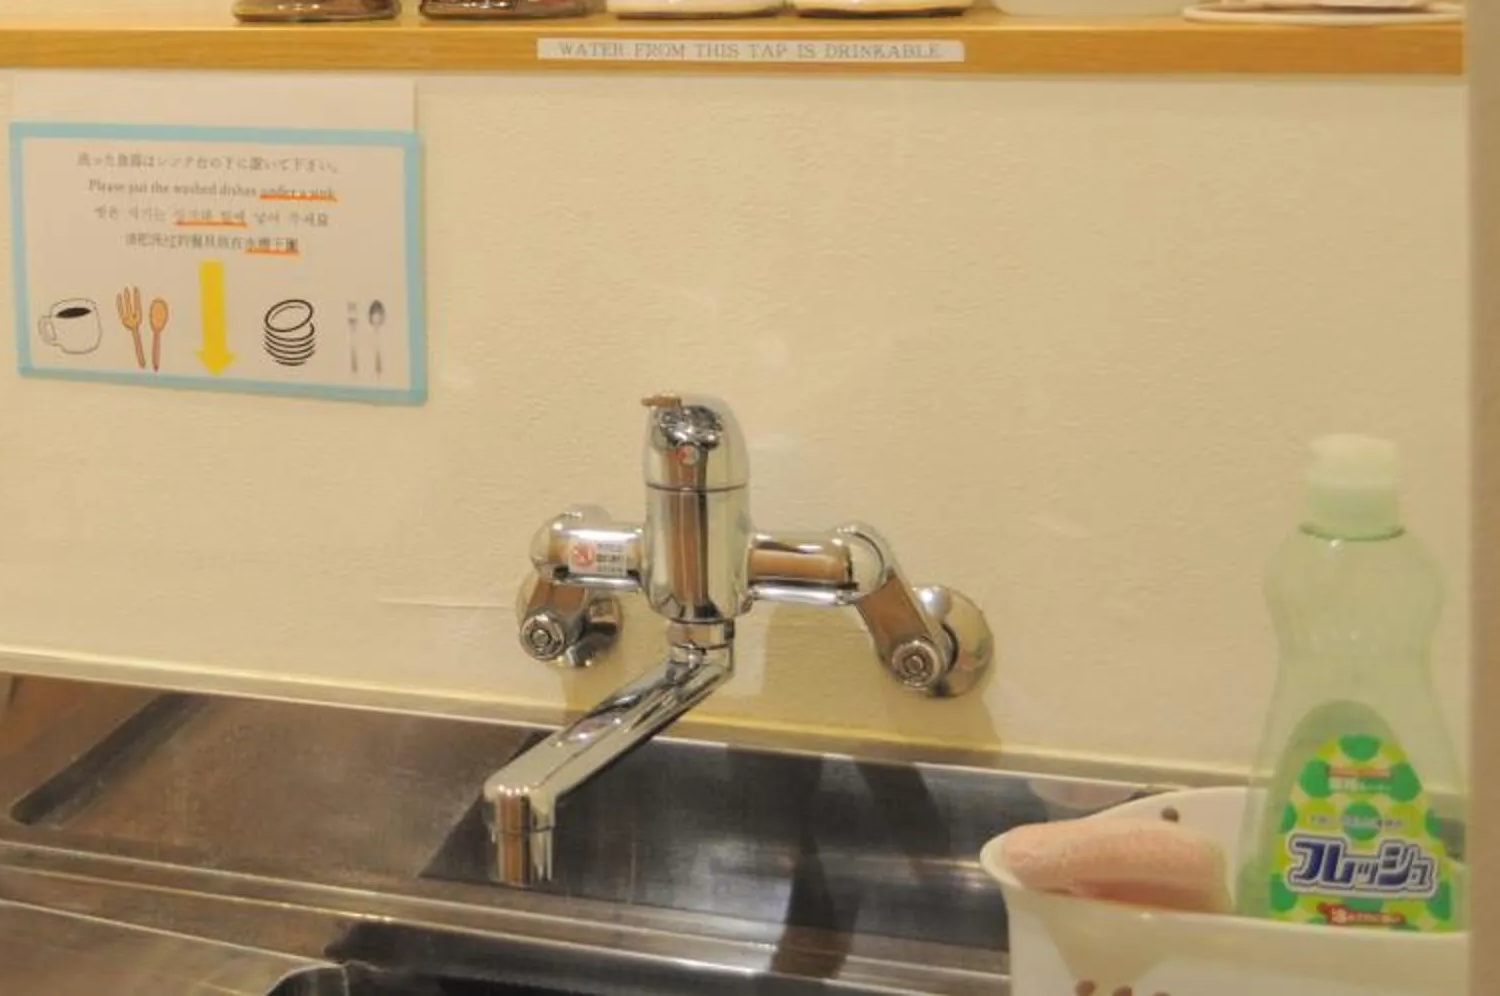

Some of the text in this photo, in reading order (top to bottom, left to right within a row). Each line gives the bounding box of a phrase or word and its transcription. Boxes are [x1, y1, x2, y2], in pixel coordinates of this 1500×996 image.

[558, 42, 943, 59] WATER FROM THIS TAP IS DRINKABLE
[88, 178, 124, 192] Please
[150, 180, 169, 193] the
[1290, 838, 1434, 890] フレッシュ
